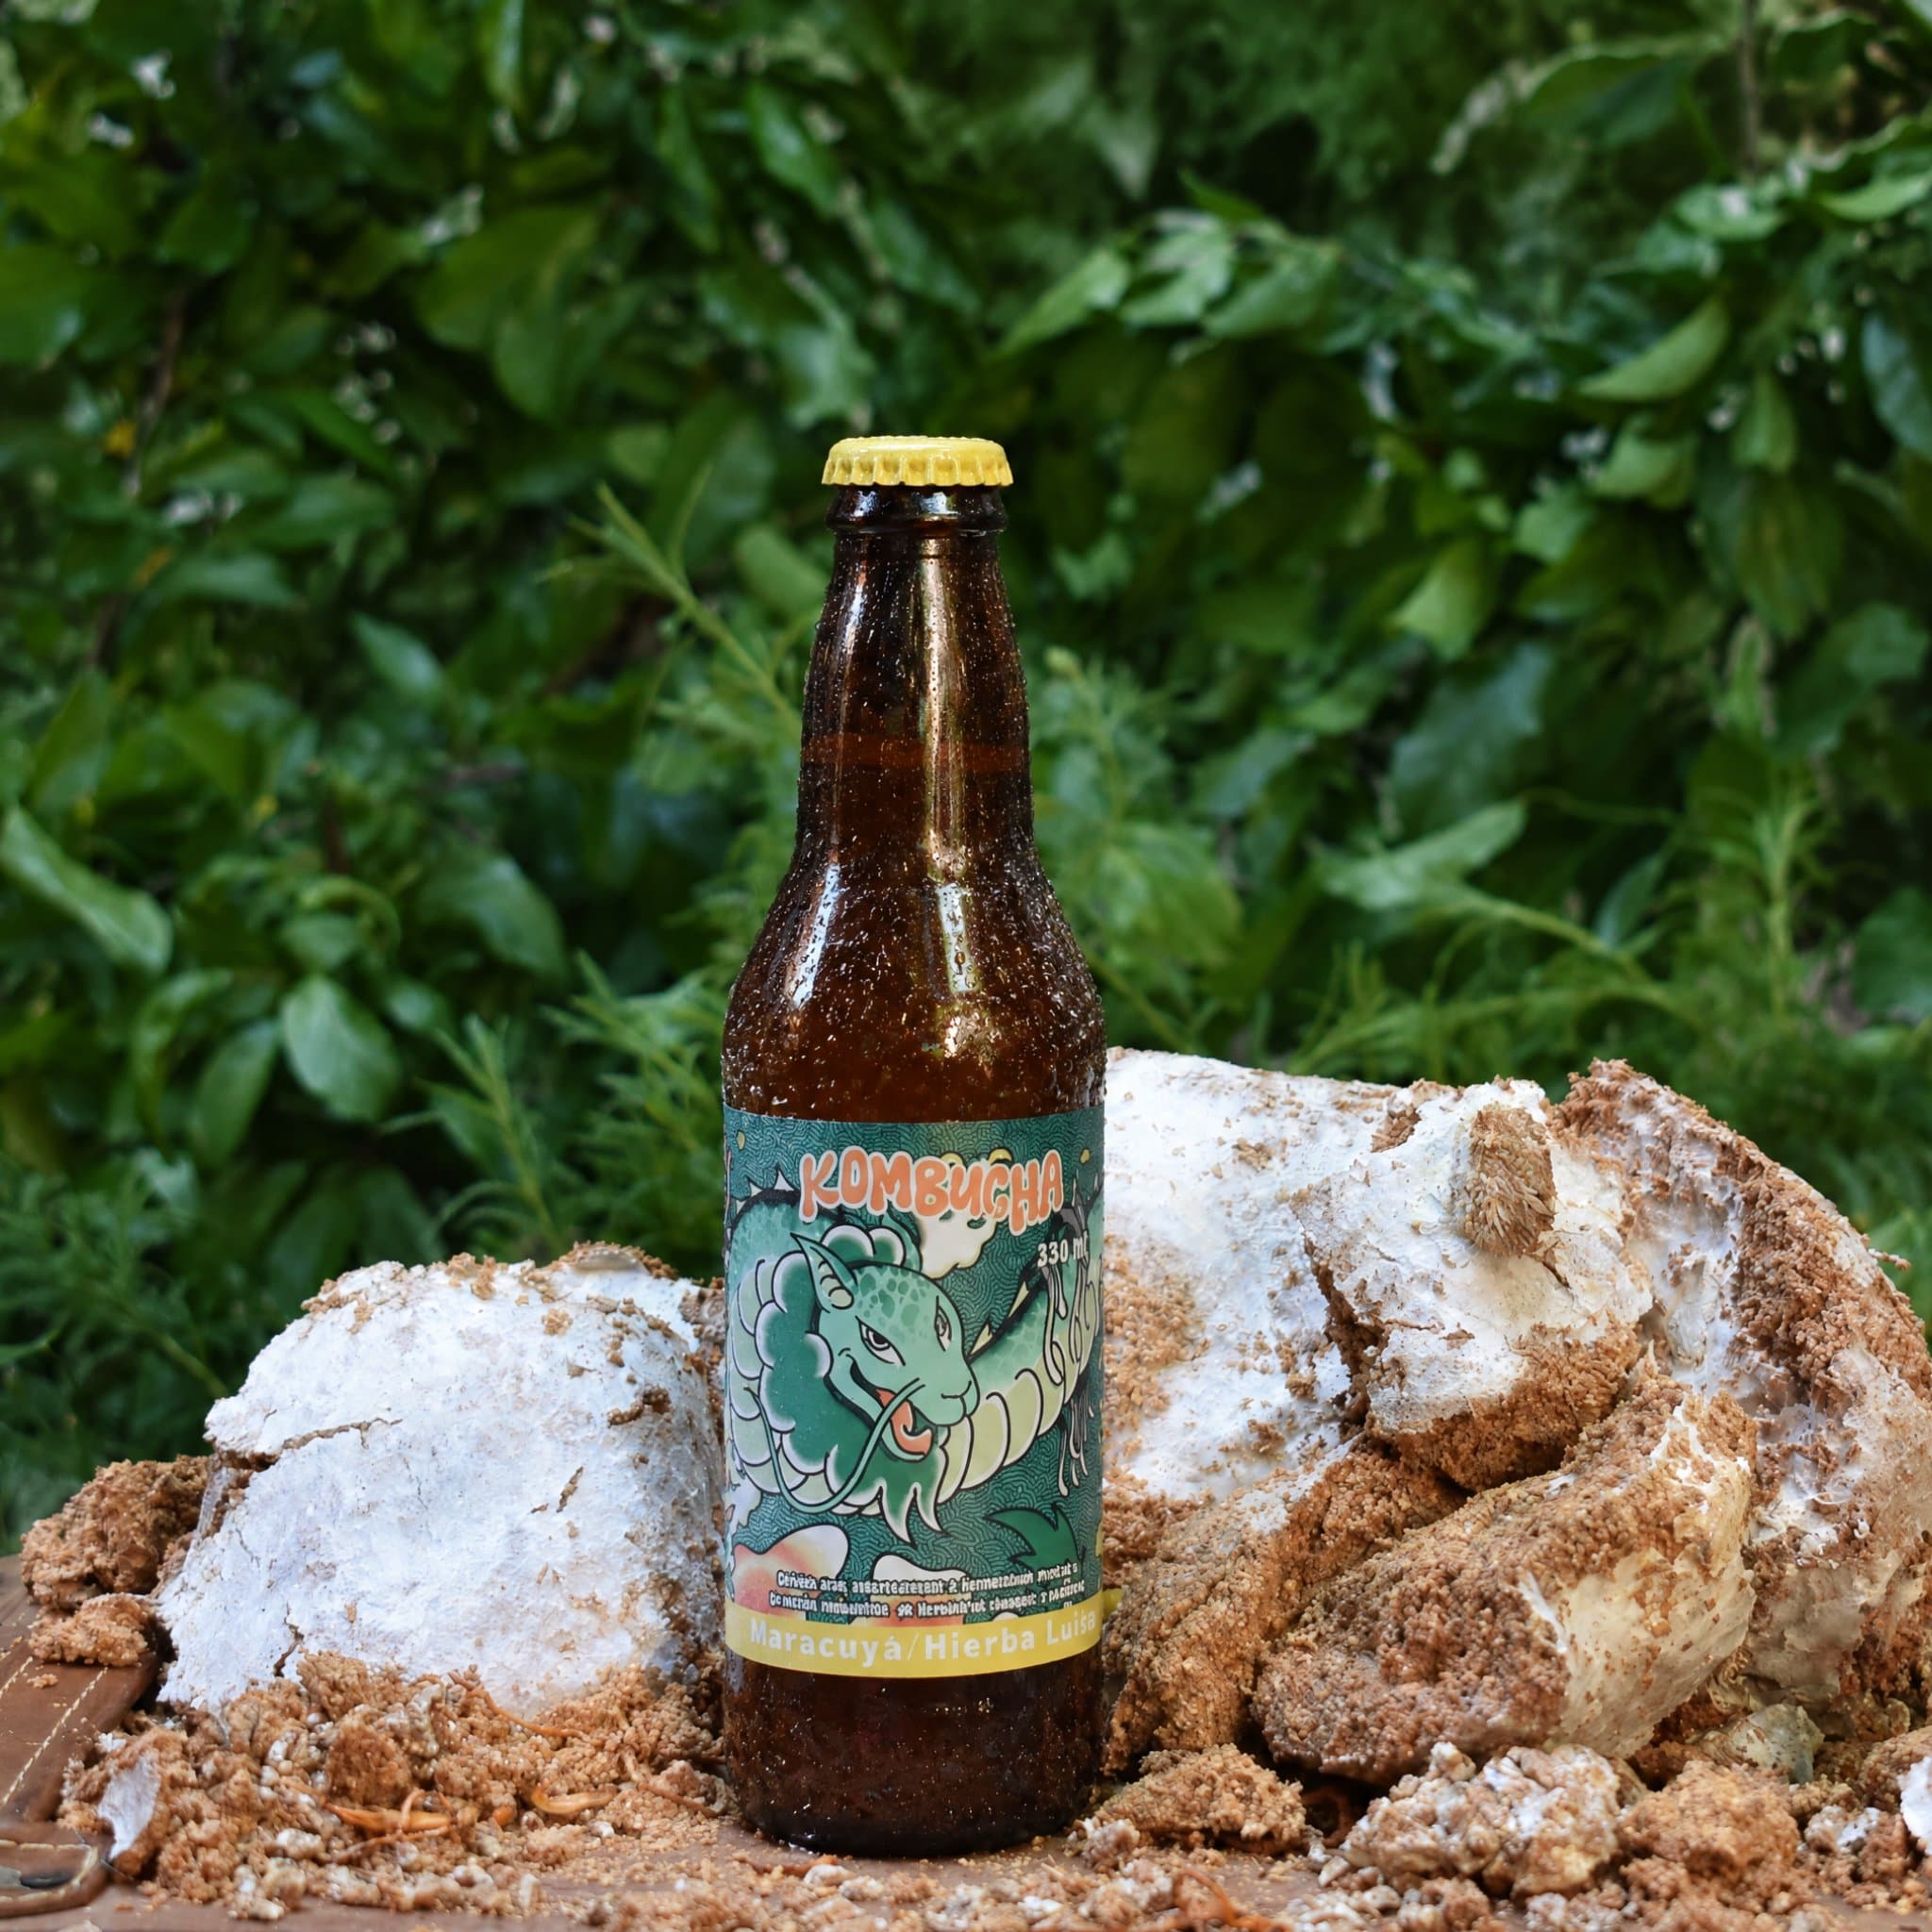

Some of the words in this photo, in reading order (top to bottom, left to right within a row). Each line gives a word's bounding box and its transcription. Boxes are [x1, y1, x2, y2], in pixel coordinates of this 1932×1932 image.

[801, 1146, 1064, 1236] KOMBUCHA
[1037, 1239, 1069, 1268] 330
[1046, 1607, 1096, 1646] Luisa
